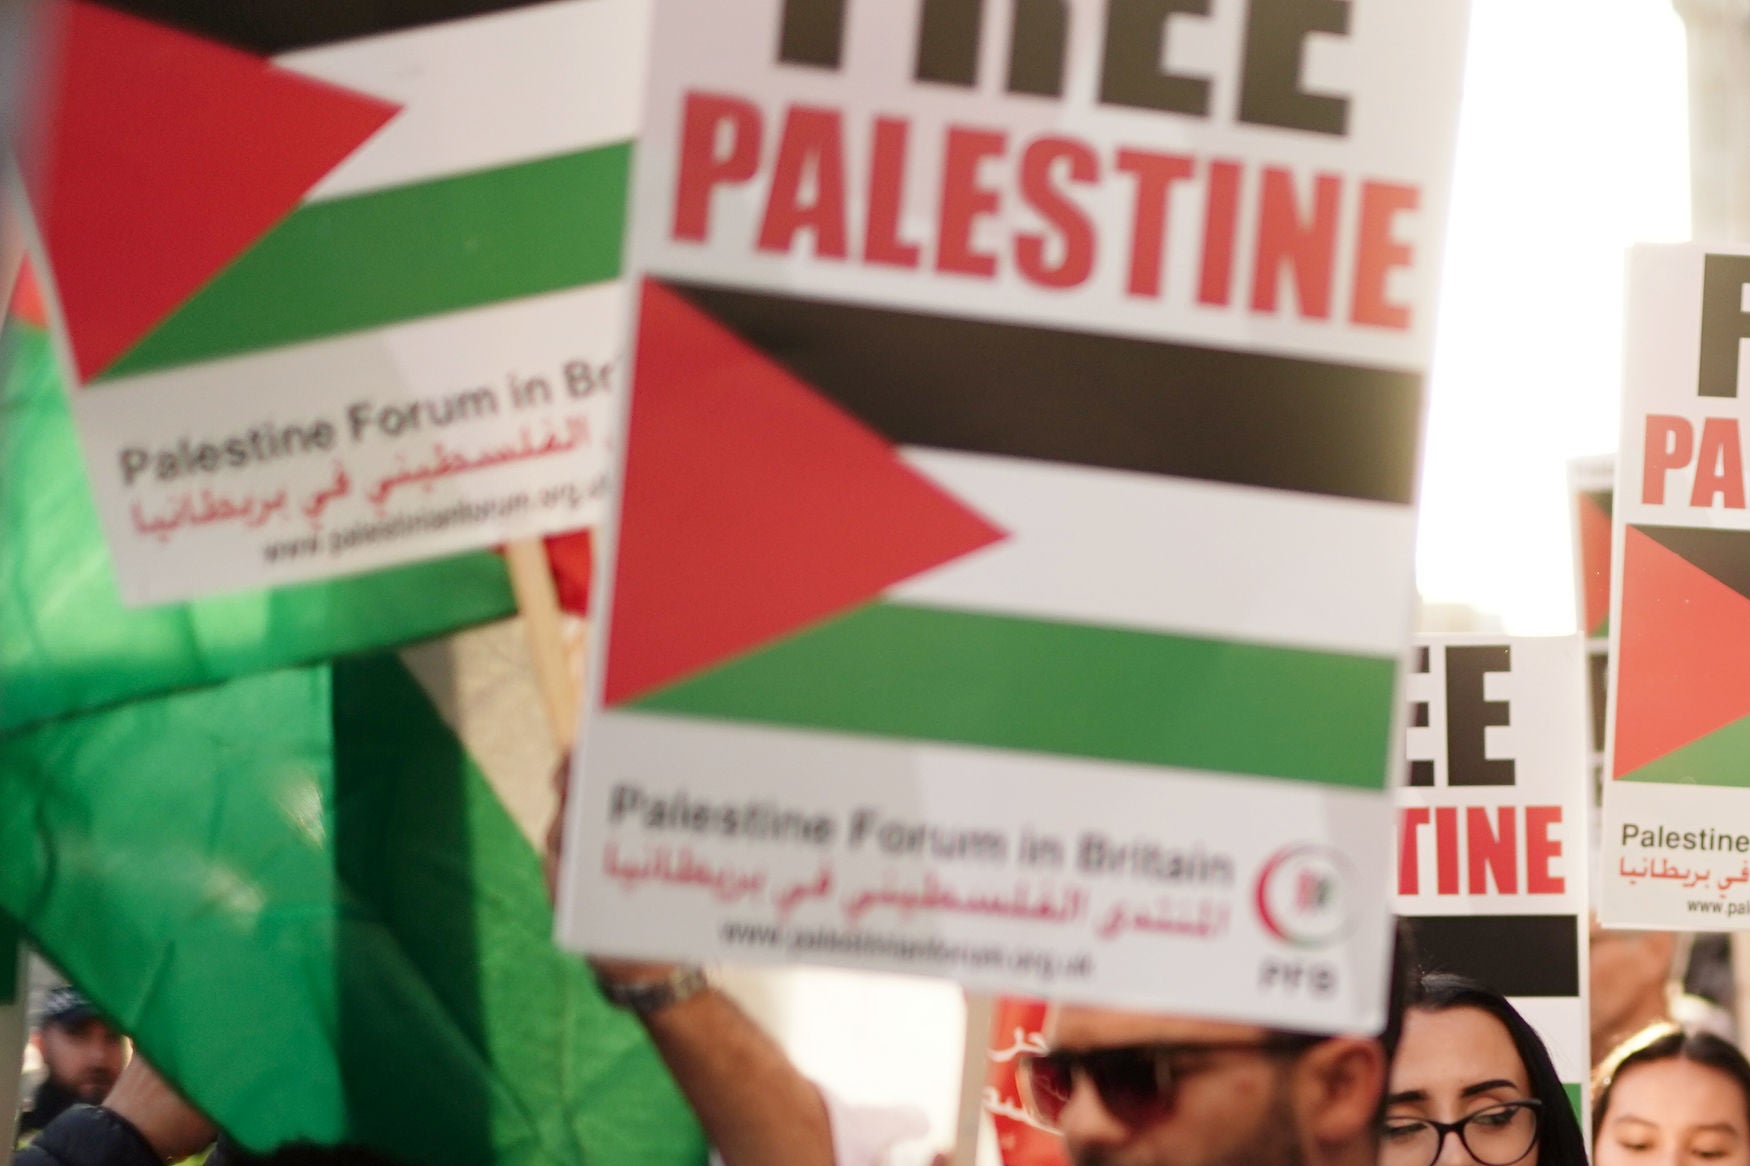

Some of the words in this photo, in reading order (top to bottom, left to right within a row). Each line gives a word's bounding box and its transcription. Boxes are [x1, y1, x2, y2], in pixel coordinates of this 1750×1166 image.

[668, 88, 1422, 331] PALESTINE
[119, 418, 335, 488] Palestine
[345, 388, 499, 443] Forum
[508, 372, 552, 410] in
[608, 782, 834, 846] Palestine
[847, 806, 1007, 860] Forum
[1018, 823, 1064, 868] in
[1076, 830, 1236, 886] Britain
[1622, 823, 1750, 853] Palestine
[1619, 856, 1711, 888] بريطانيا
[1717, 859, 1750, 899] في
